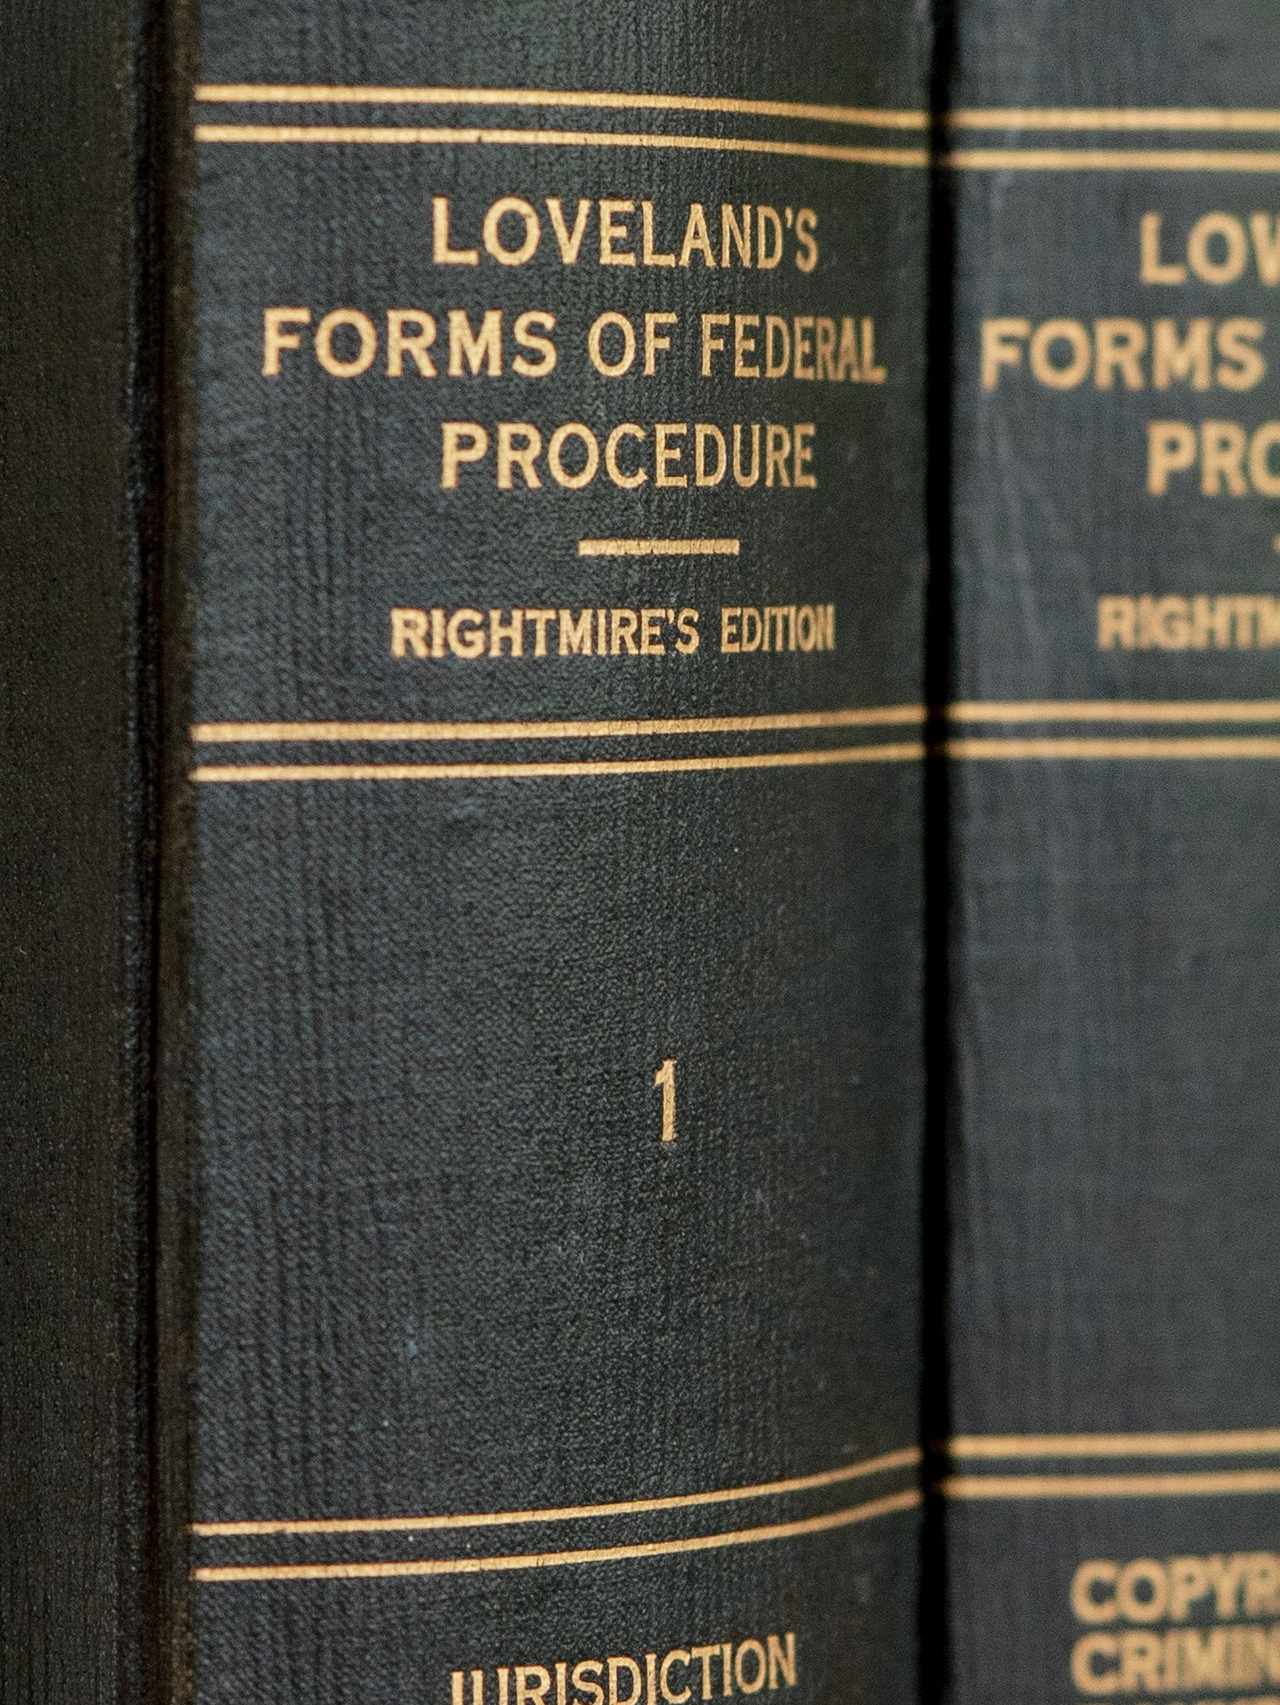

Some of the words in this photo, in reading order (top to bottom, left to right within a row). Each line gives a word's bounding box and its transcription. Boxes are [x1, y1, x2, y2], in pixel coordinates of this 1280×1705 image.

[432, 195, 819, 273] LOVELAND'S
[262, 306, 558, 379] FORMS
[587, 310, 678, 378] OF
[701, 313, 886, 383] FEDERAL
[981, 317, 1265, 391] FORMS
[441, 420, 817, 490] PROCEDURE
[391, 606, 701, 659] RIGHTMIRE'S
[720, 604, 834, 654] EDITION
[654, 1058, 676, 1142] 1
